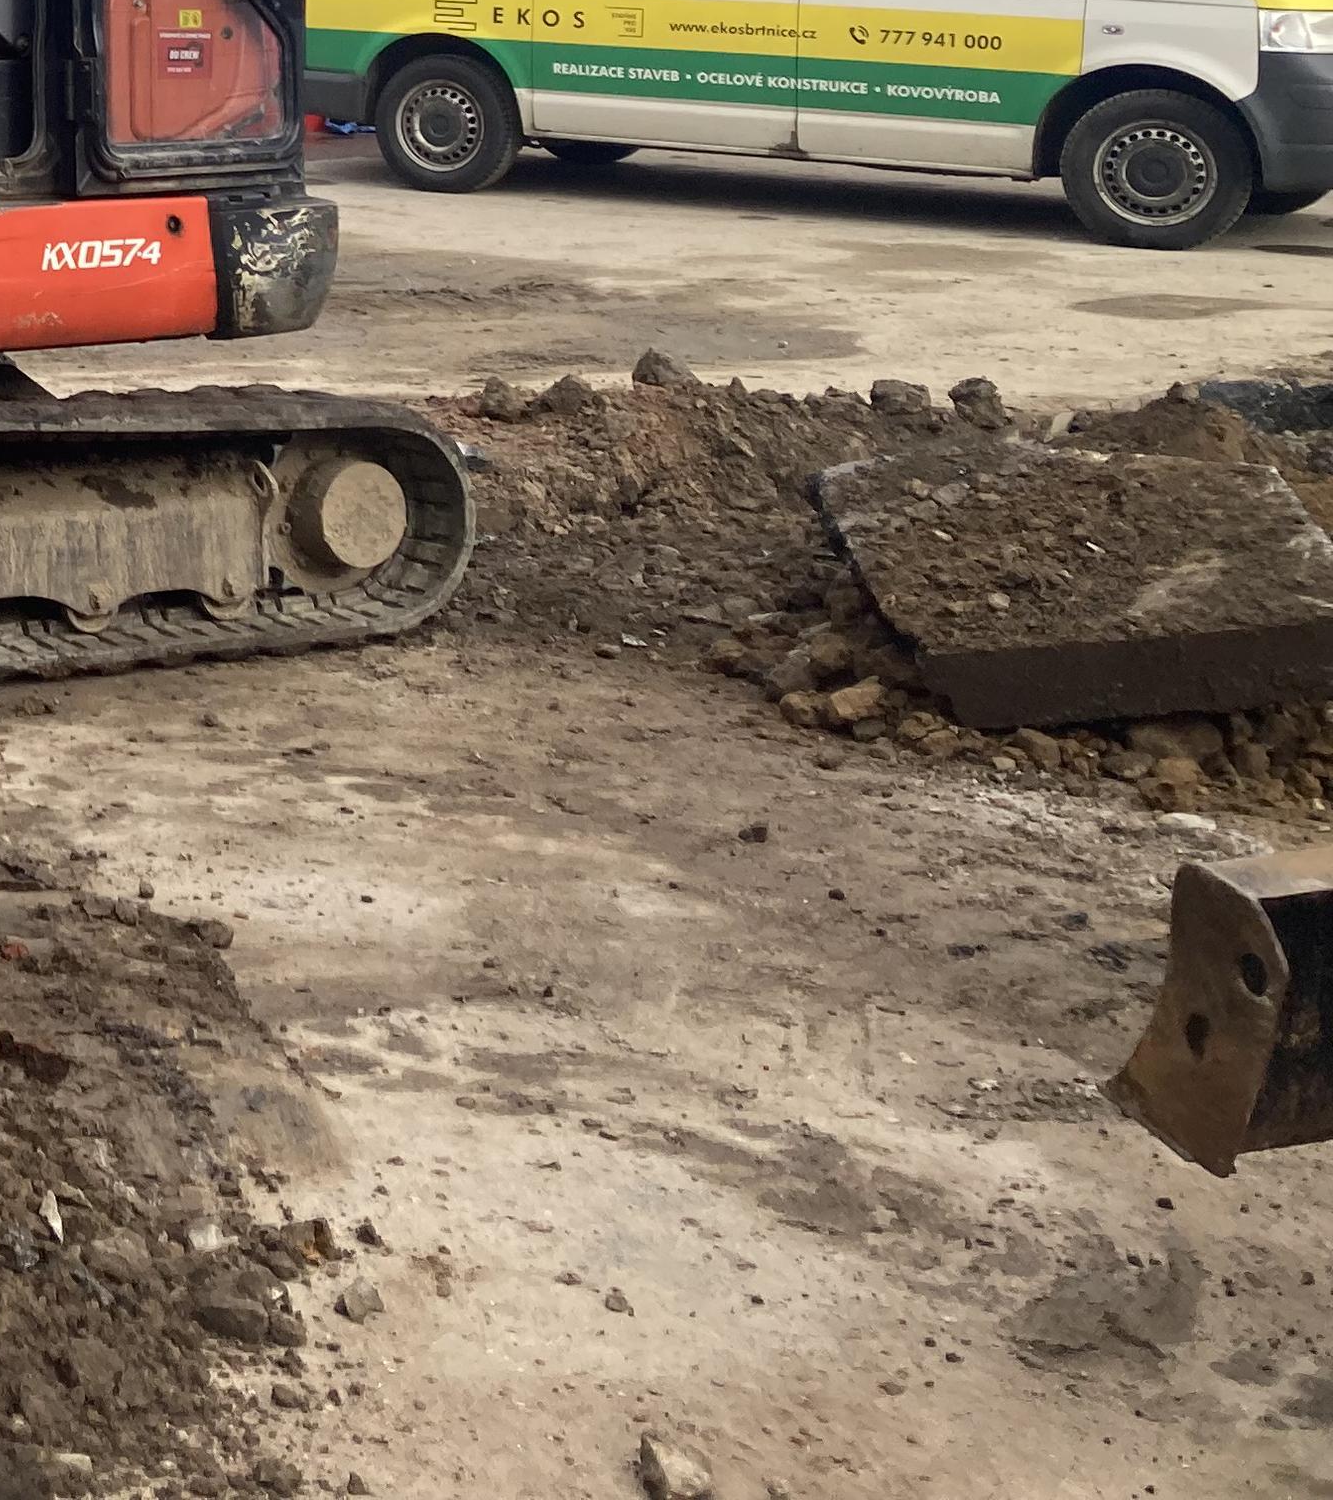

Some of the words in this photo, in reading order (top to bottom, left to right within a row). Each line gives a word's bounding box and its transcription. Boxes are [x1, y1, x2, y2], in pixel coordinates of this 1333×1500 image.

[492, 6, 586, 29] EKOS
[668, 20, 818, 40] www.ekosbrtnice.cz
[879, 29, 917, 46] 777
[921, 31, 957, 48] 941
[964, 33, 1003, 51] 000
[552, 62, 625, 80] REALIZACE
[628, 67, 680, 82] STAVEB
[696, 69, 764, 88] OCELOVÉ
[767, 76, 869, 96] KONSTRUKCE
[886, 81, 1002, 105] KOVOVÝROBA
